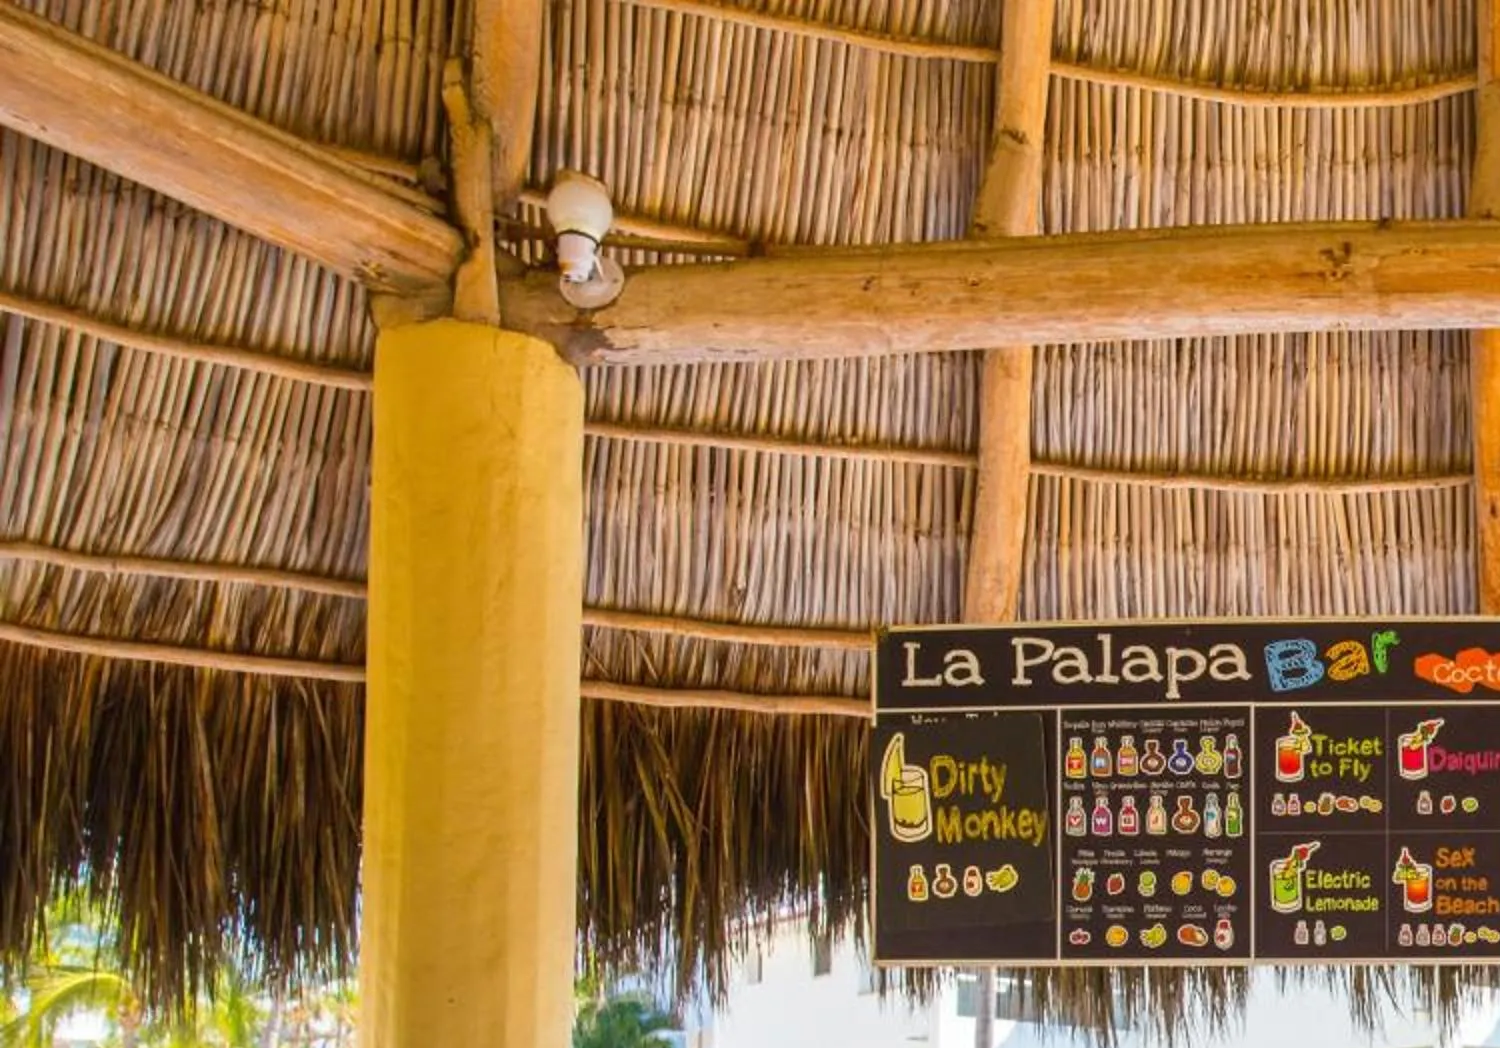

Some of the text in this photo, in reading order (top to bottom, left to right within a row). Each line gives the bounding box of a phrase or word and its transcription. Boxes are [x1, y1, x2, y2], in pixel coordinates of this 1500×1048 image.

[902, 630, 1401, 700] La Palapa Bar
[1311, 733, 1384, 756] Ticket
[929, 754, 1008, 802] Dirty
[1309, 759, 1373, 783] to Fly
[935, 803, 1048, 848] Monkey
[1305, 869, 1372, 889] Electric
[1435, 874, 1488, 892] on the
[1305, 896, 1380, 913] Lemonade
[1435, 897, 1500, 916] Beach
